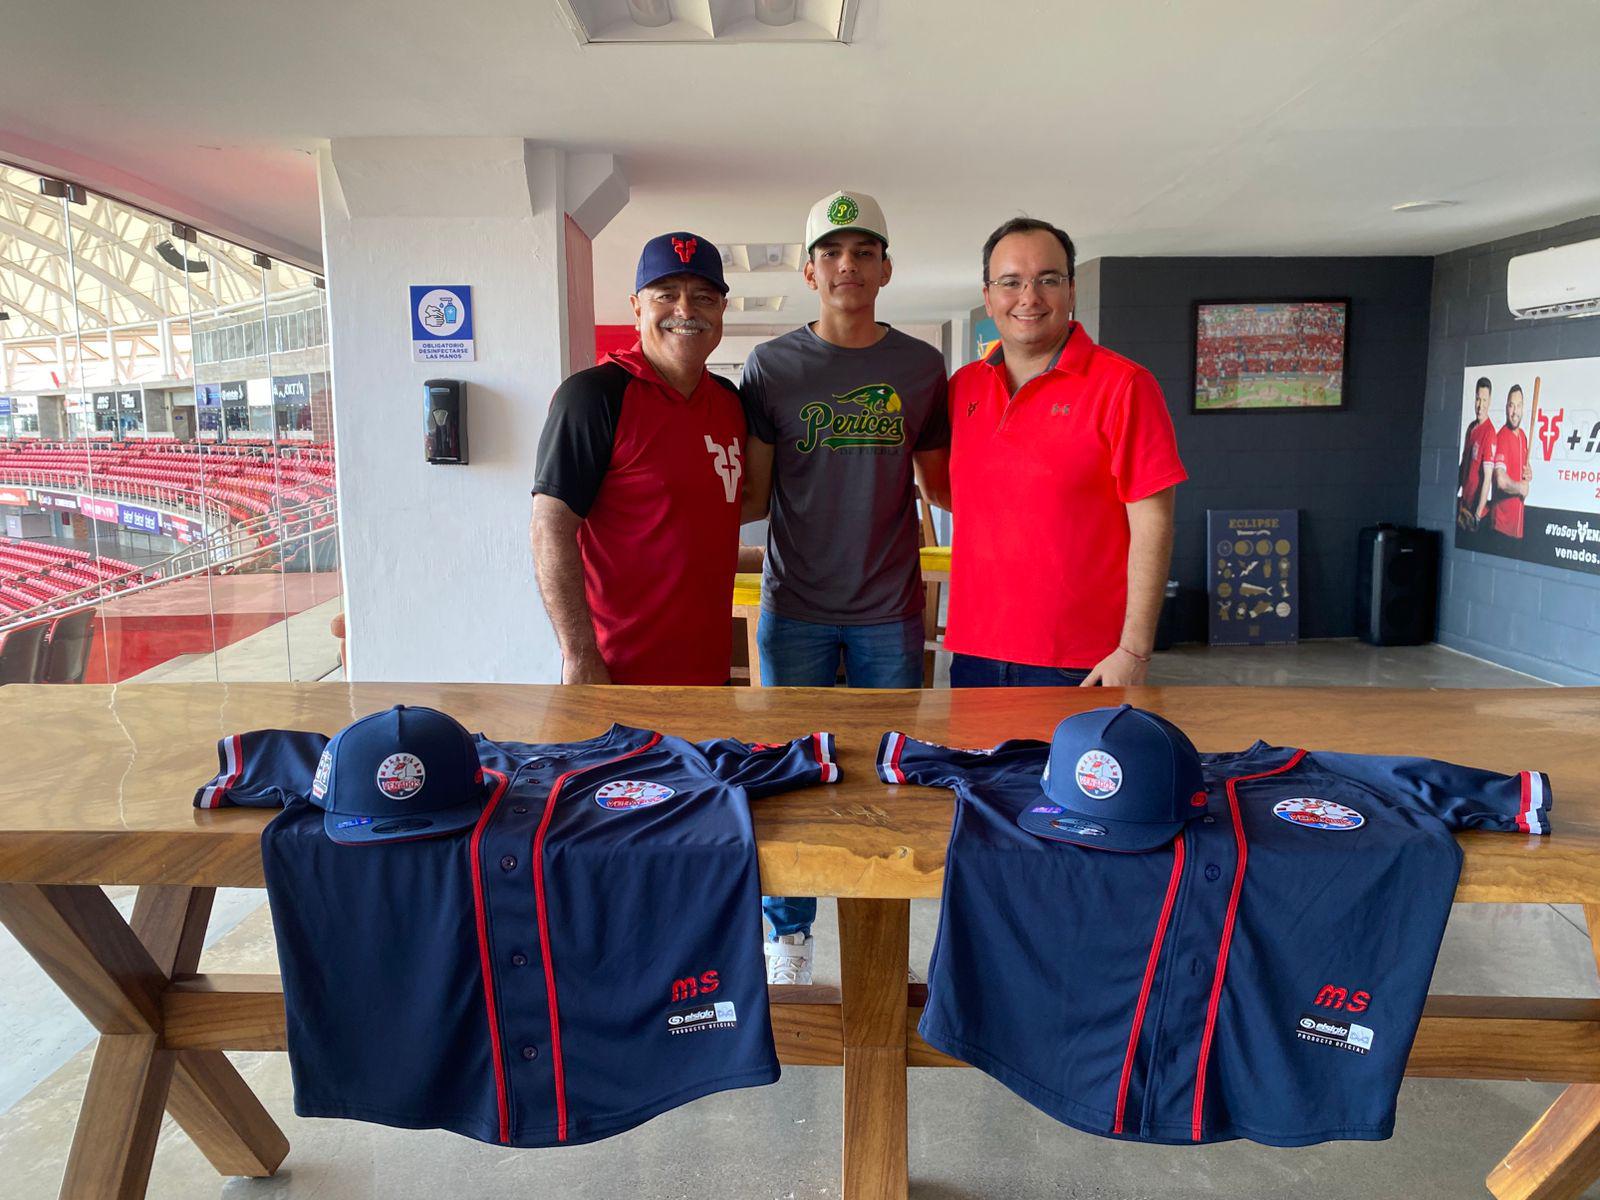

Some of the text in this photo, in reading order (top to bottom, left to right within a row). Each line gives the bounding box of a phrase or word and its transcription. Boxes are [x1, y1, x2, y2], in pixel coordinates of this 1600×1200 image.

[796, 401, 905, 454] Pericos
[1228, 518, 1280, 529] ECLIPSE
[671, 1025, 705, 1035] PRODUCTO
[1297, 1033, 1365, 1054] PRODUCTO OFICIAL
